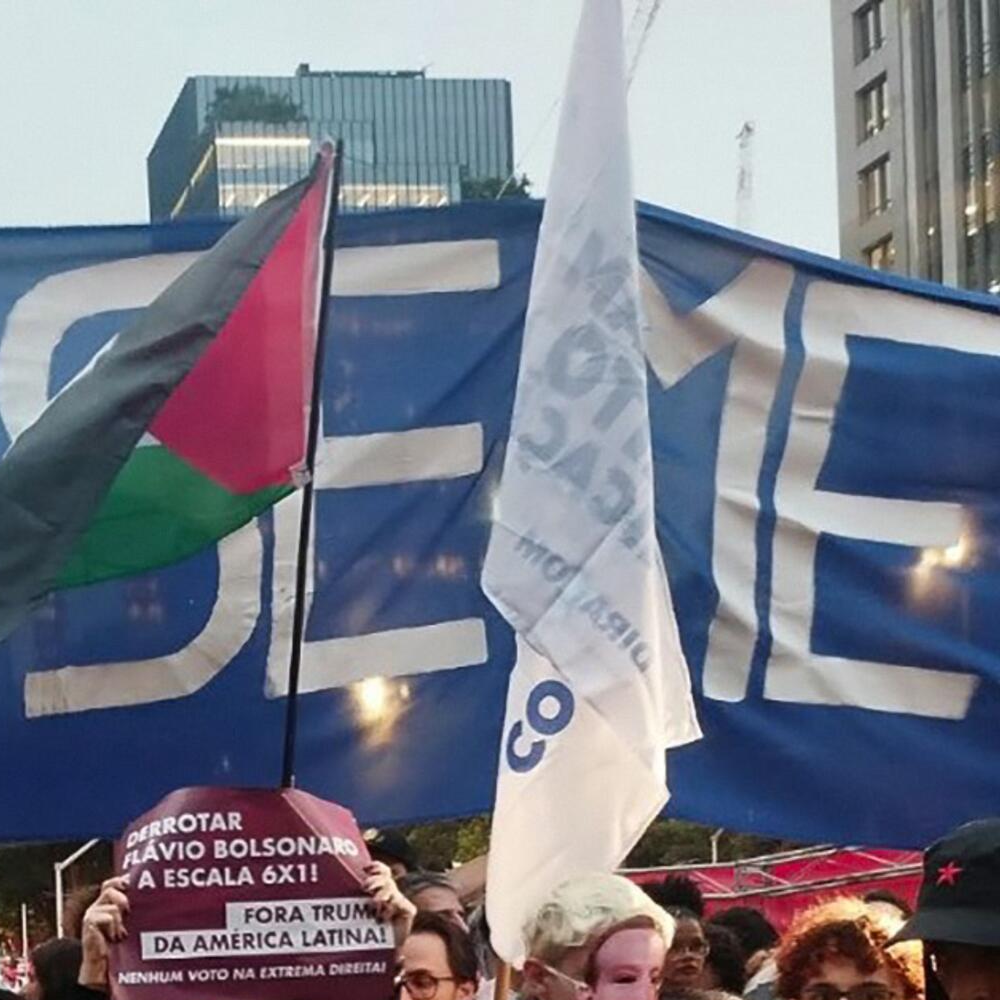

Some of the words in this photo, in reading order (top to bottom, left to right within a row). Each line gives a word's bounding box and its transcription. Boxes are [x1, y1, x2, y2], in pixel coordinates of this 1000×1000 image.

[126, 812, 242, 848] DERROTAR
[122, 837, 205, 869] FLÁVIO
[214, 836, 358, 861] BOLSONARO
[137, 869, 156, 890] A
[164, 867, 253, 889] ESCALA
[262, 864, 318, 885] 6X1!
[244, 905, 304, 925] FORA
[312, 903, 381, 924] TRUM
[154, 936, 185, 954] DA
[193, 928, 293, 951] AMÉRICA
[301, 927, 387, 948] LATINA!
[118, 970, 183, 986] NENHUM
[188, 968, 228, 982] VOTO
[233, 967, 255, 981] NA
[260, 964, 325, 980] EXTREMA
[329, 961, 387, 977] DIREITA!
